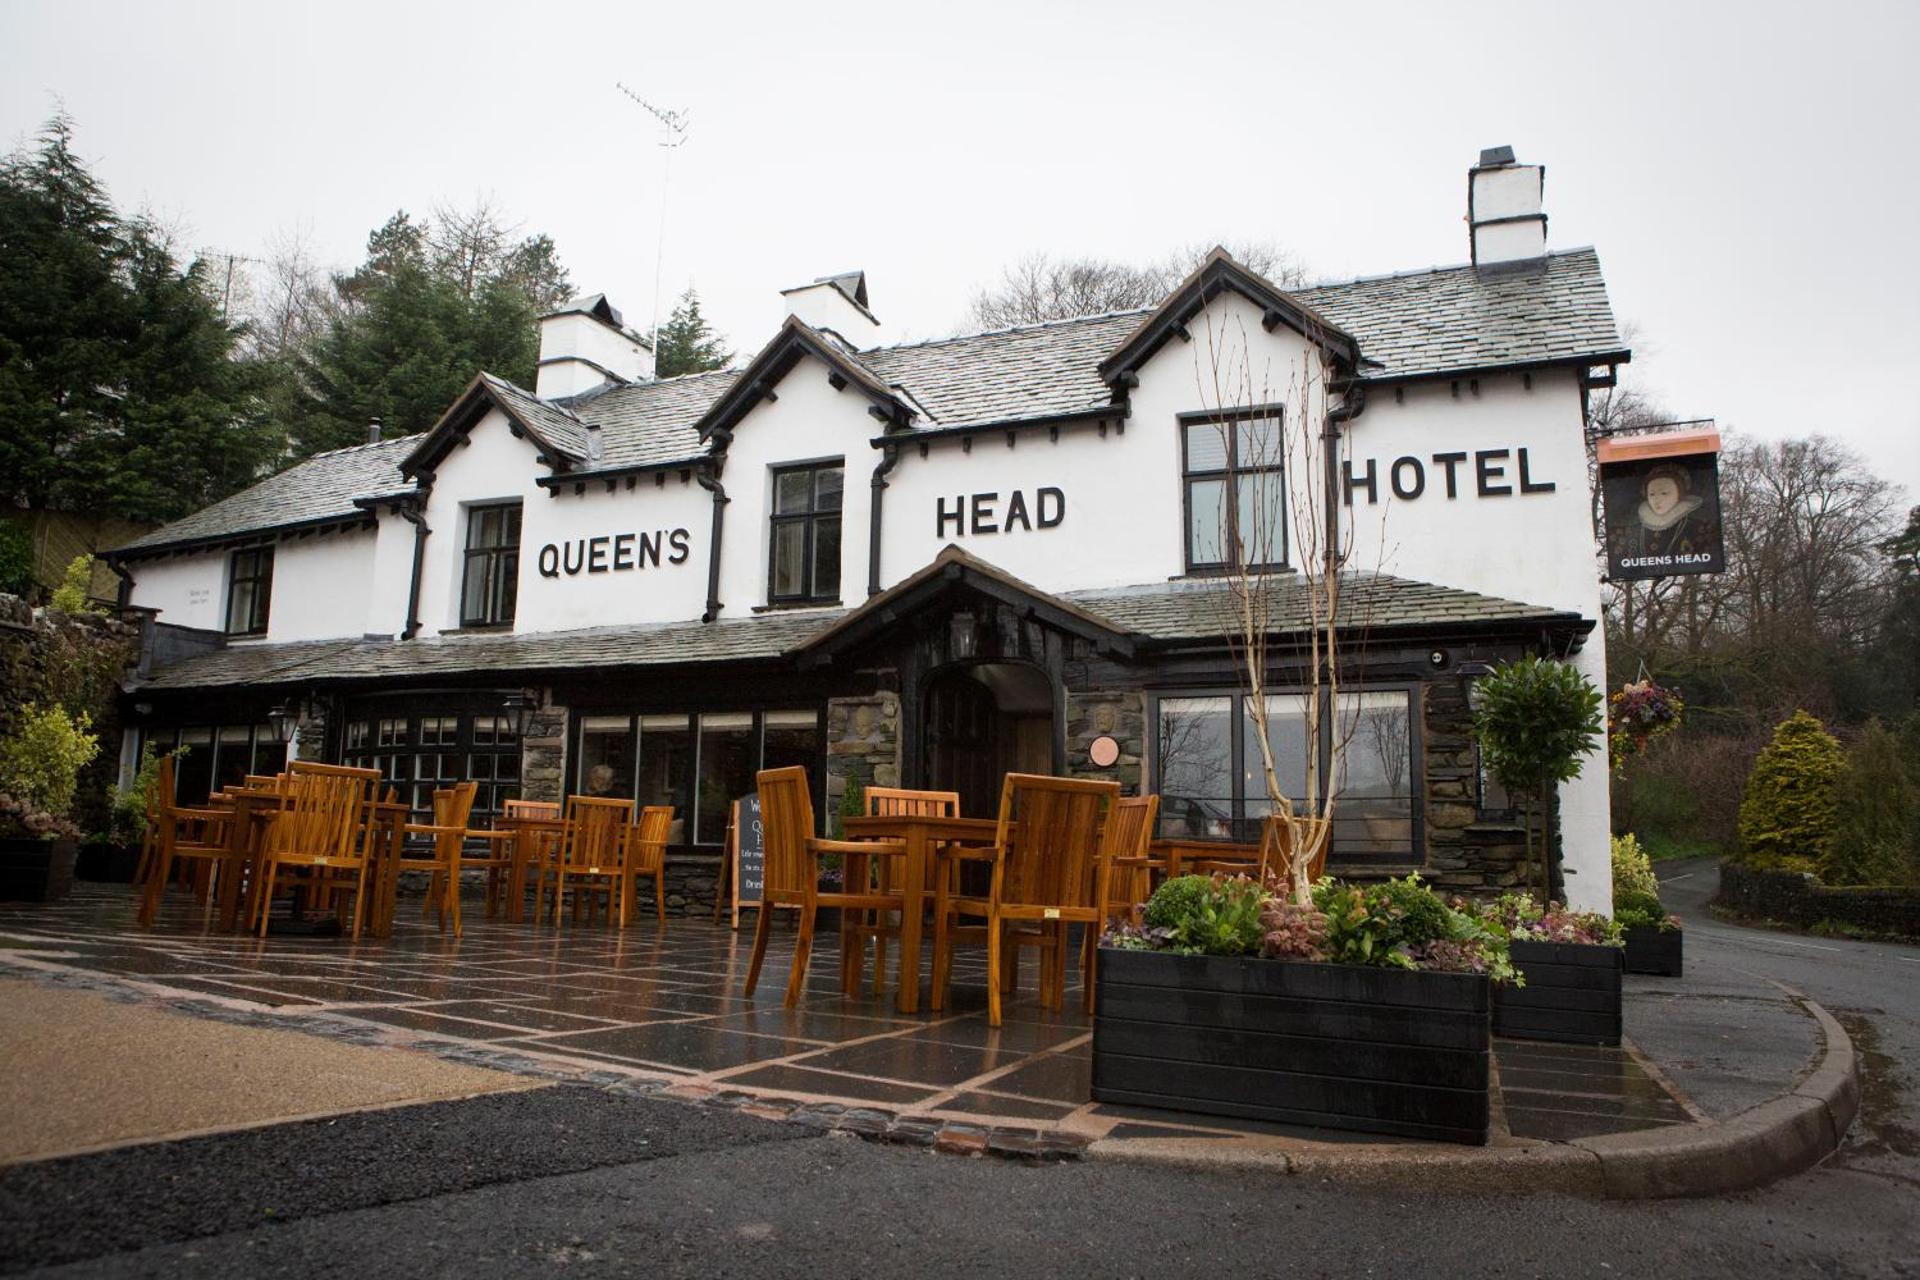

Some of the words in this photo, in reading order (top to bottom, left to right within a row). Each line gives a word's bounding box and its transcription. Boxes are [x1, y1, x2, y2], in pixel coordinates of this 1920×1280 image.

[538, 528, 690, 578] QUEEN'S
[936, 487, 1066, 538] HEAD
[1342, 447, 1556, 506] HOTEL
[1621, 555, 1673, 568] QUEENS
[1675, 552, 1711, 564] HEAD
